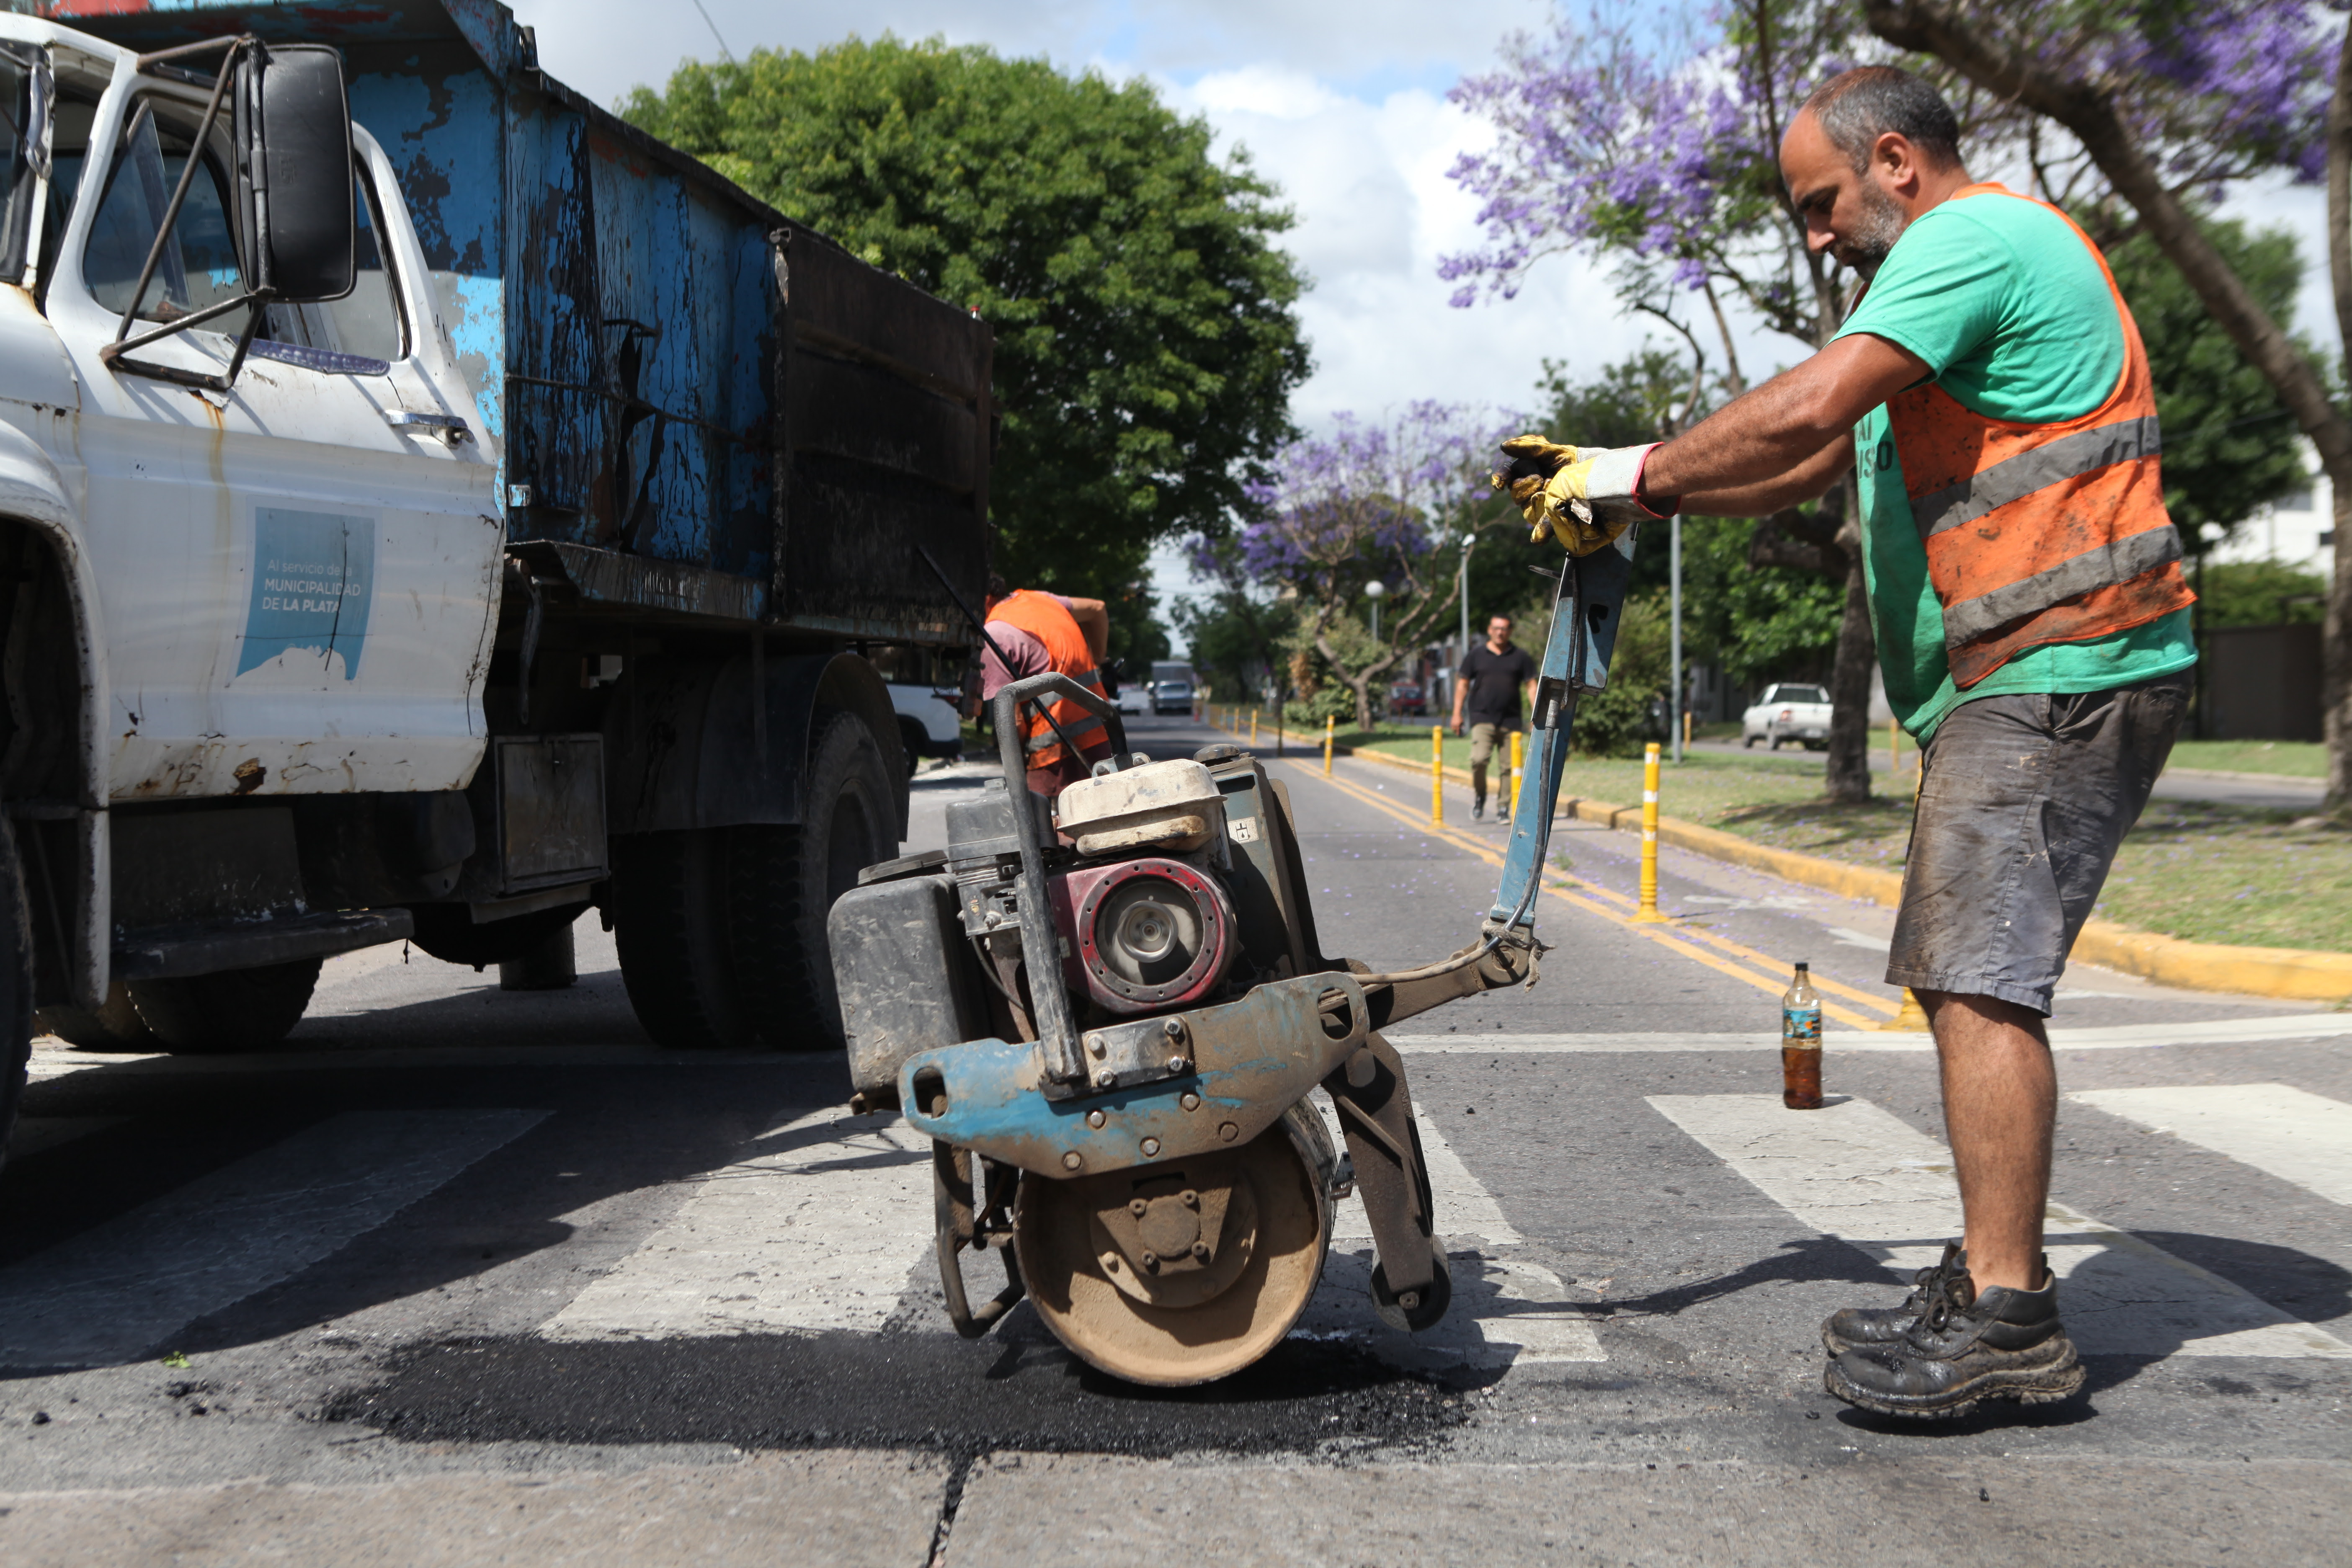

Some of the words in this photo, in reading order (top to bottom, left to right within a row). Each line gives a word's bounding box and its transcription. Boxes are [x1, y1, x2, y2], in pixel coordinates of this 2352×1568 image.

[1856, 441, 1893, 479] ISO
[267, 560, 279, 571] Al
[282, 562, 324, 574] servicio
[327, 564, 340, 575] de
[265, 578, 361, 596] MUNICIPALIDAD
[263, 597, 280, 610] DE
[283, 598, 299, 611] LA
[302, 599, 340, 613] PLATA
